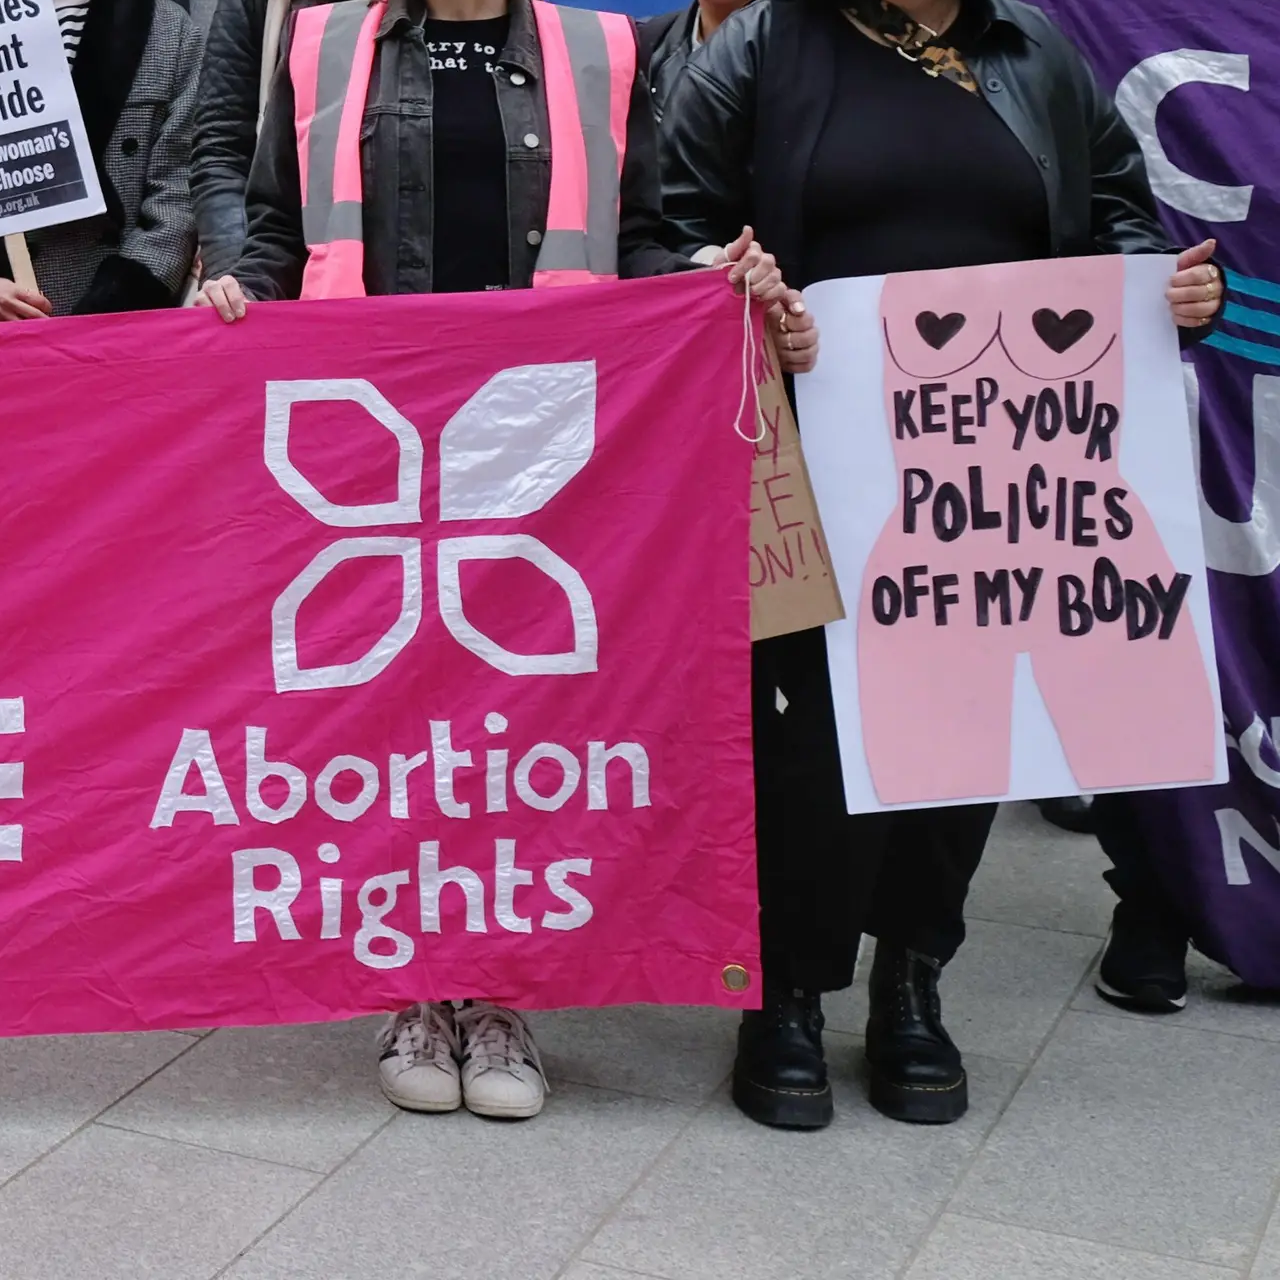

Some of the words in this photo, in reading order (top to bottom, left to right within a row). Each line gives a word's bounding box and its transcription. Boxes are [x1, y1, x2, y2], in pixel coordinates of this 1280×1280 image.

[429, 57, 467, 70] hat
[893, 377, 1000, 445] KEEP
[1002, 380, 1120, 462] YOUR
[902, 463, 1134, 548] POLICIES
[872, 565, 960, 626] OFF
[974, 566, 1043, 627] MY
[1057, 556, 1192, 641] BODY
[148, 711, 652, 829] Abortion
[232, 838, 594, 969] Rights
